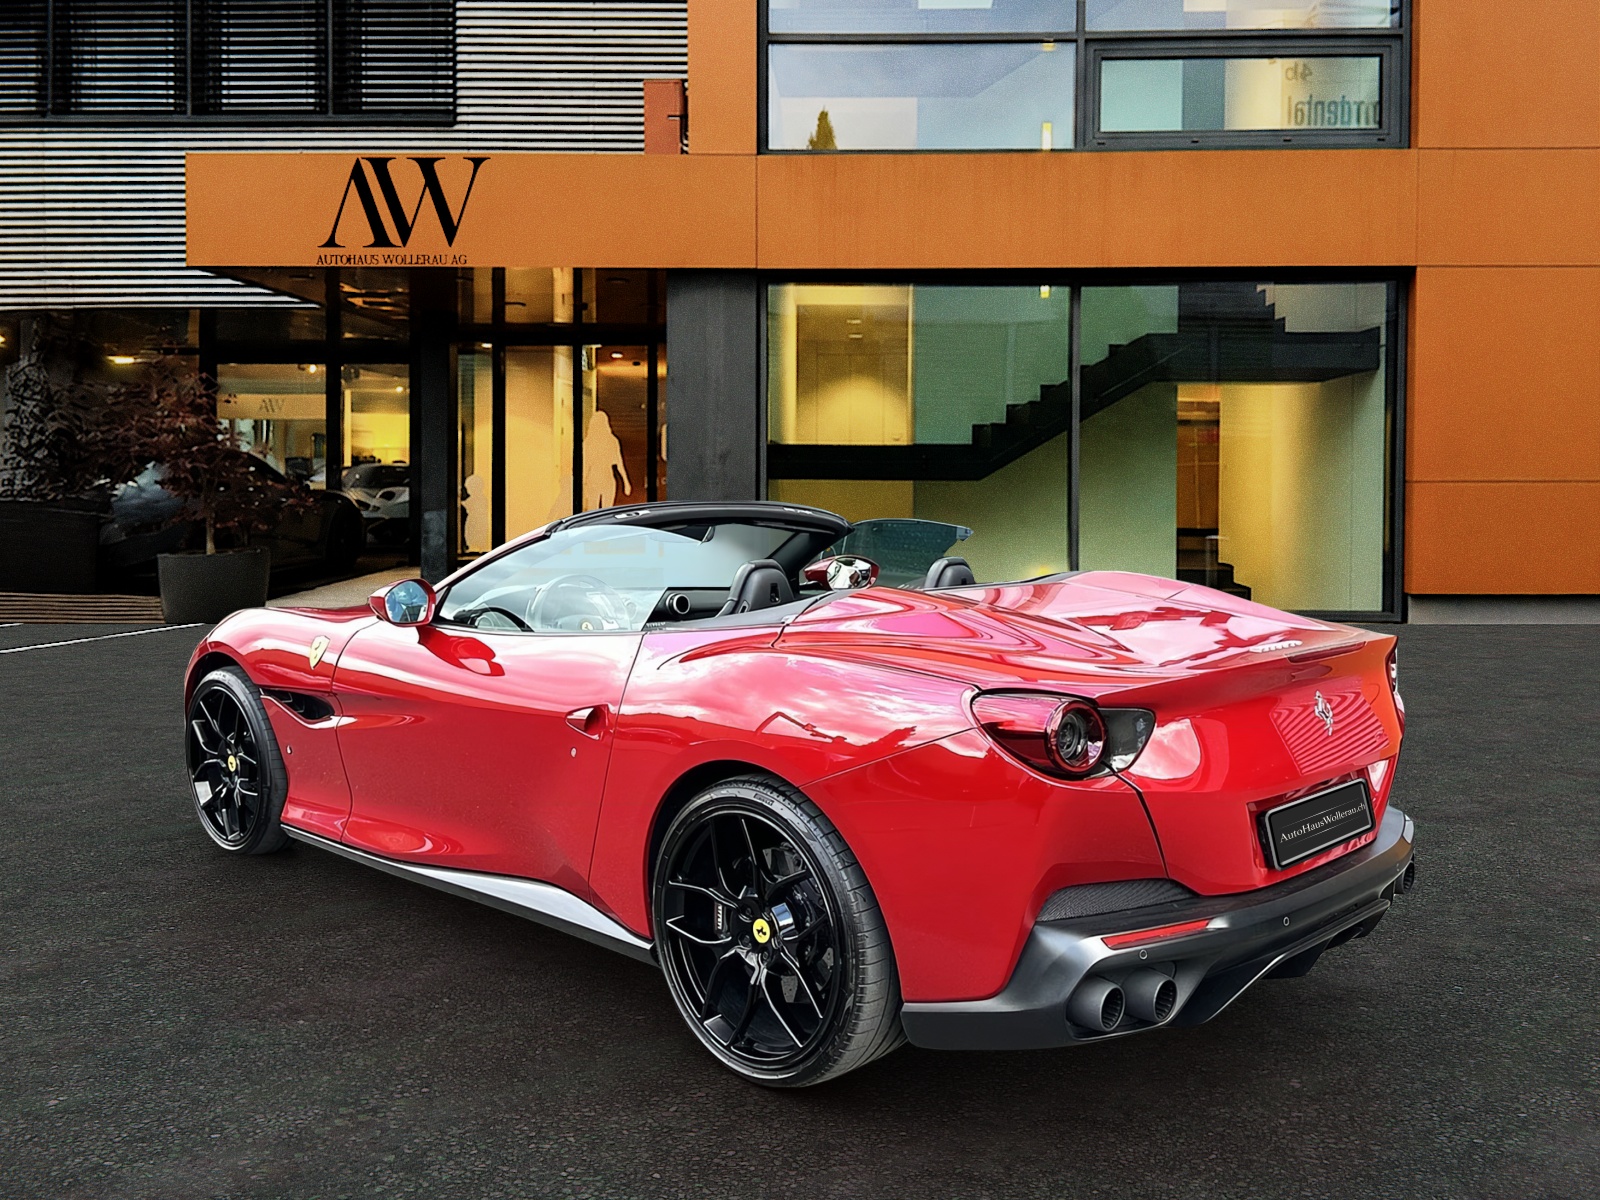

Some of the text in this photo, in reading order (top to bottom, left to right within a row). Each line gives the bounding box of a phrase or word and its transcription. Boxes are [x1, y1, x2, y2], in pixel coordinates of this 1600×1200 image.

[317, 156, 492, 249] AW
[316, 254, 468, 266] AUTOHAUS WOLLERAU AG
[1280, 802, 1367, 844] AutoHausWollerau.ch
